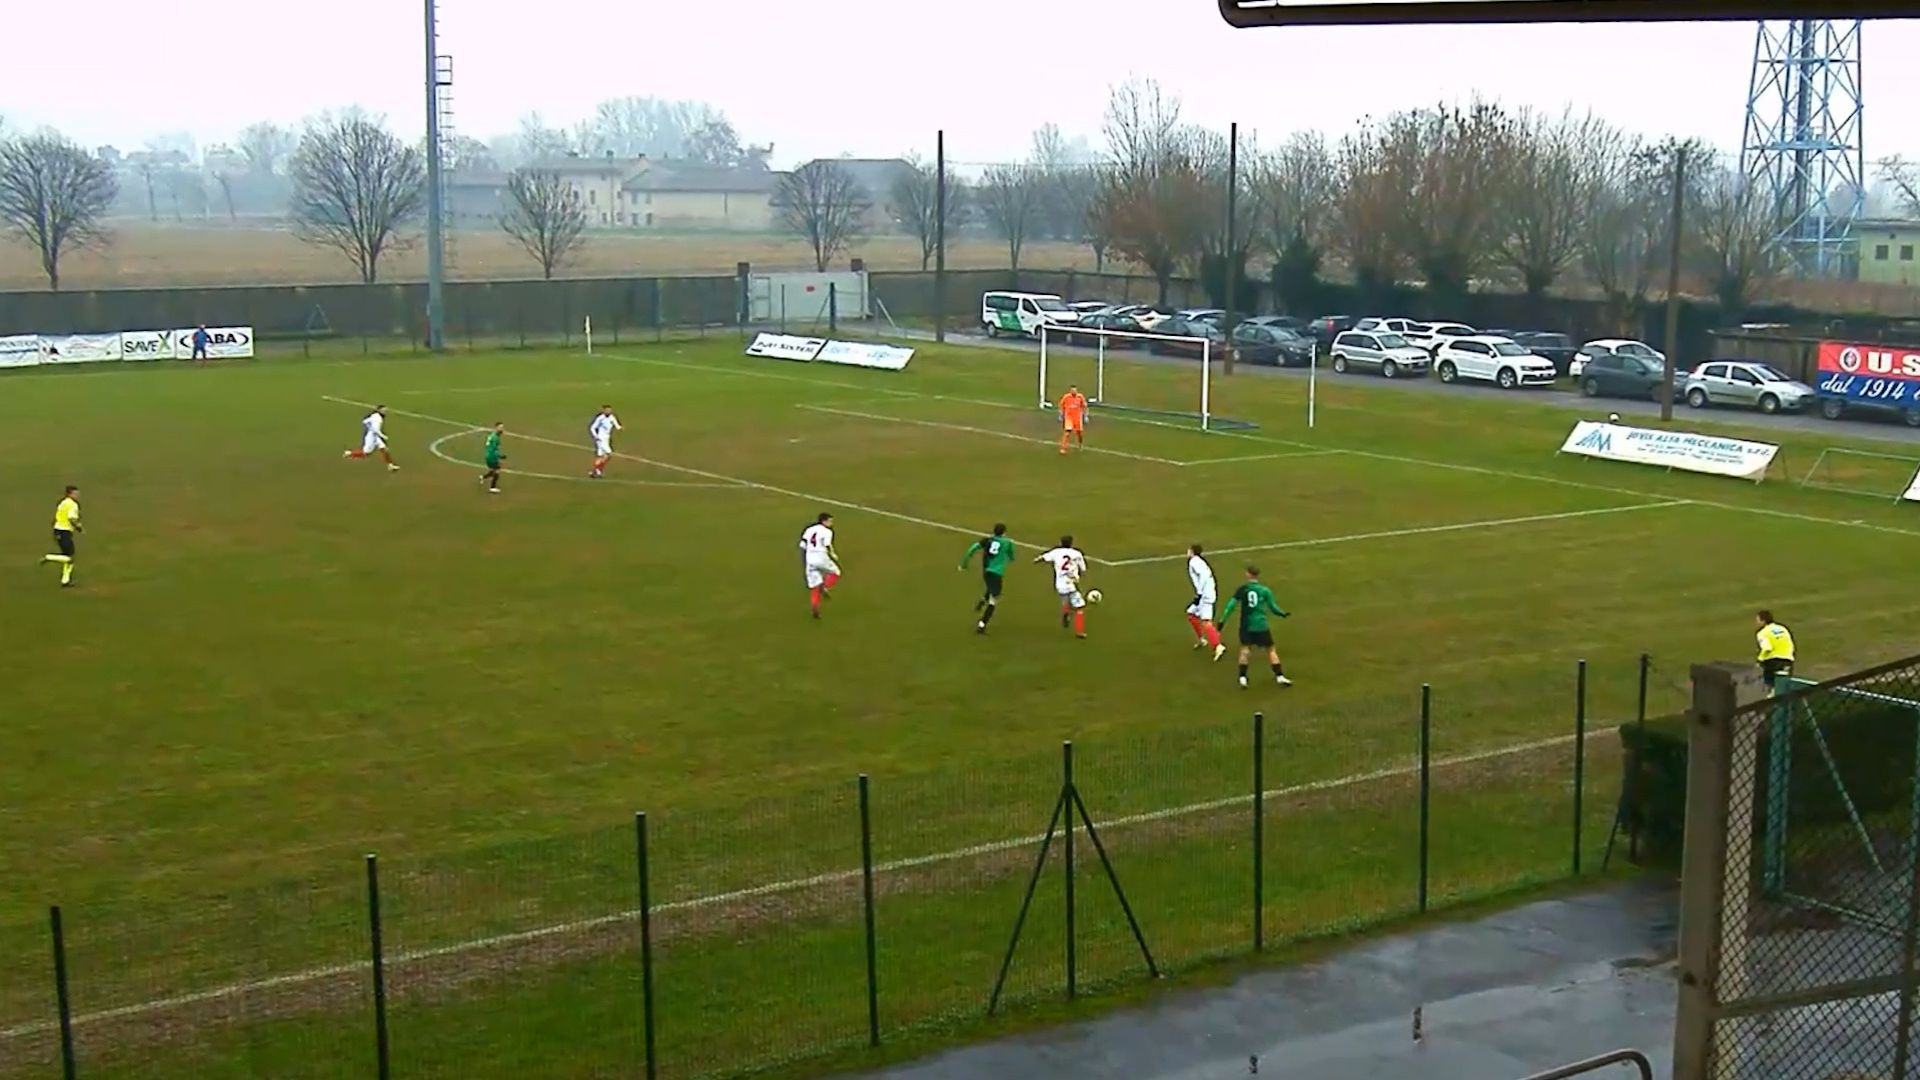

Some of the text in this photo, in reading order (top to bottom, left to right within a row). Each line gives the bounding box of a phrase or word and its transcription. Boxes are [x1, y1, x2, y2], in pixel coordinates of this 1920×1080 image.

[124, 330, 171, 353] SAVEX
[1820, 373, 1855, 393] dal
[1859, 379, 1906, 400] 1914
[809, 532, 818, 548] 4
[988, 540, 1001, 555] 8
[1060, 554, 1072, 571] 2
[1247, 590, 1259, 608] 9
